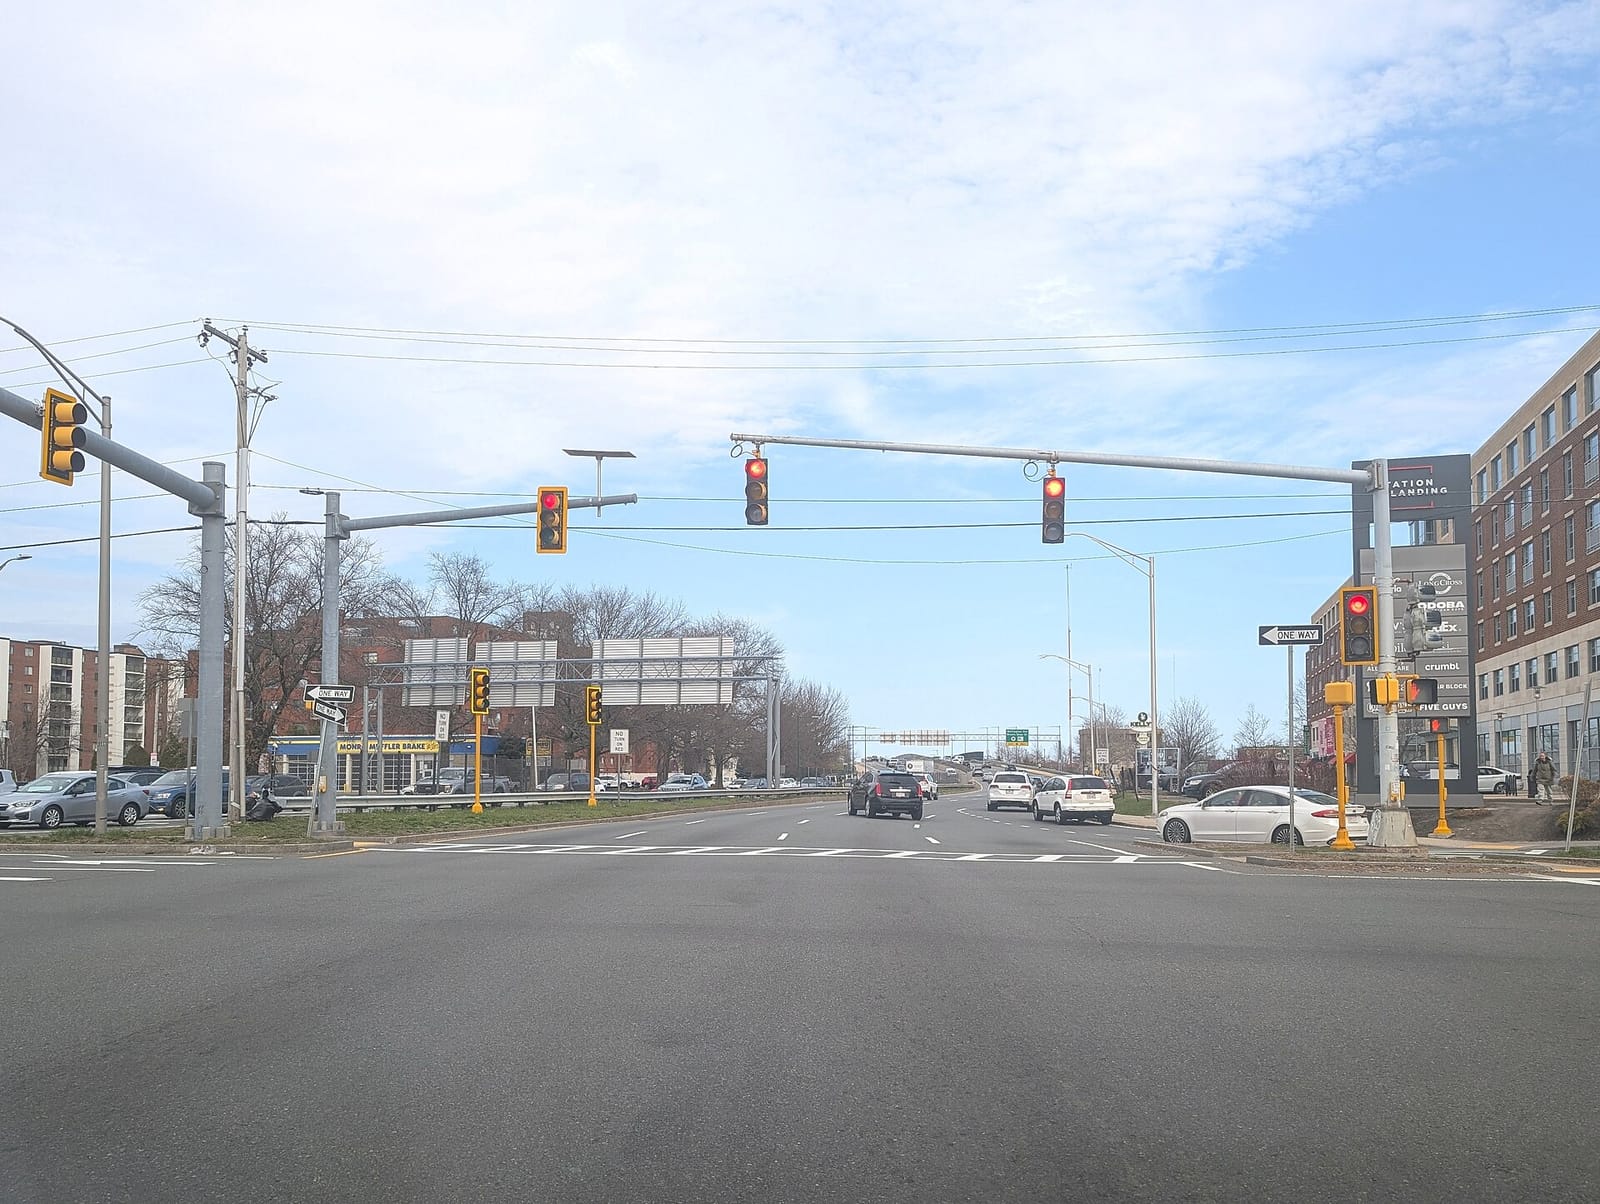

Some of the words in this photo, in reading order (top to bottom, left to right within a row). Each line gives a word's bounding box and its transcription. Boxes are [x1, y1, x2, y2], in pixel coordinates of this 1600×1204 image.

[1391, 487, 1448, 497] LANDING
[1277, 631, 1295, 640] ONE
[1297, 631, 1316, 639] WAY
[1425, 662, 1460, 671] crumbl
[1420, 703, 1440, 711] FIVE
[1442, 702, 1468, 710] GUYS
